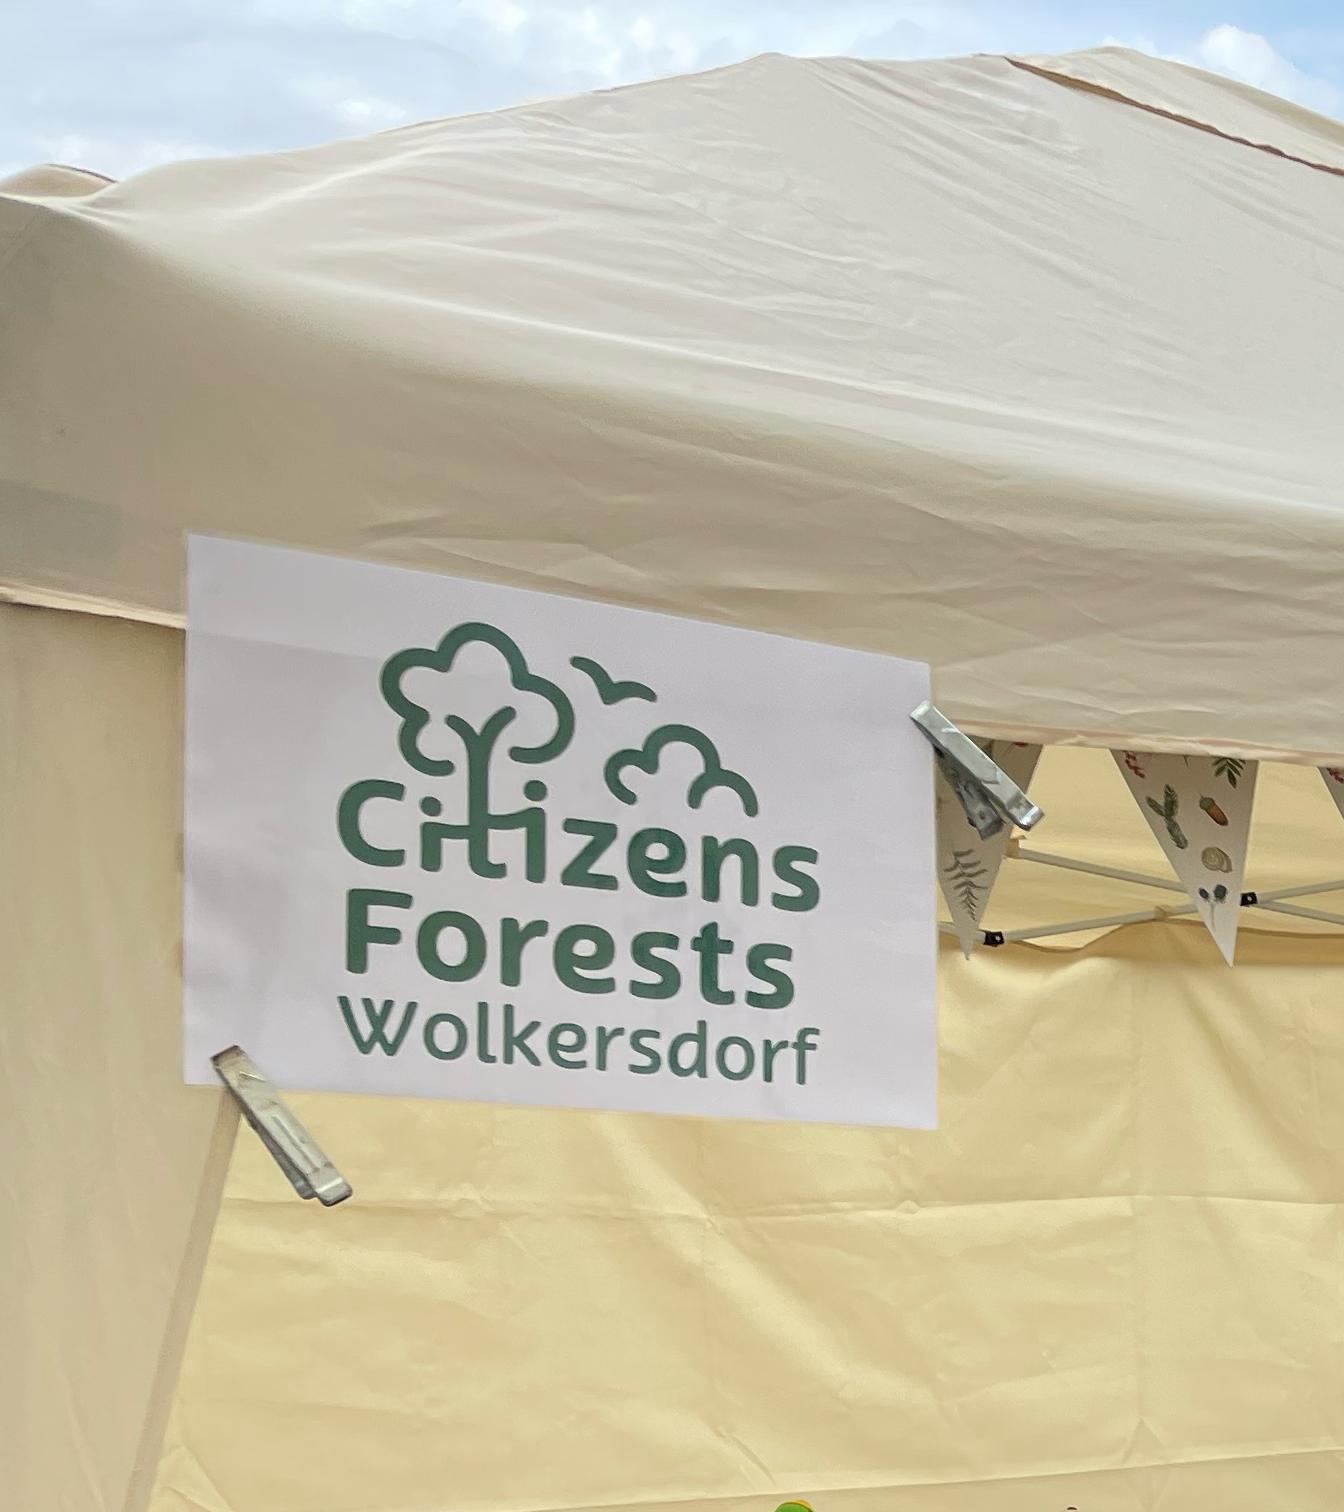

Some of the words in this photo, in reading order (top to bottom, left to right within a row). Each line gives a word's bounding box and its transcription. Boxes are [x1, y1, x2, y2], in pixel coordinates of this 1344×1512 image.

[336, 778, 822, 912] Citizens
[345, 888, 795, 1010] Forests
[338, 995, 820, 1086] Wolkersdorf
